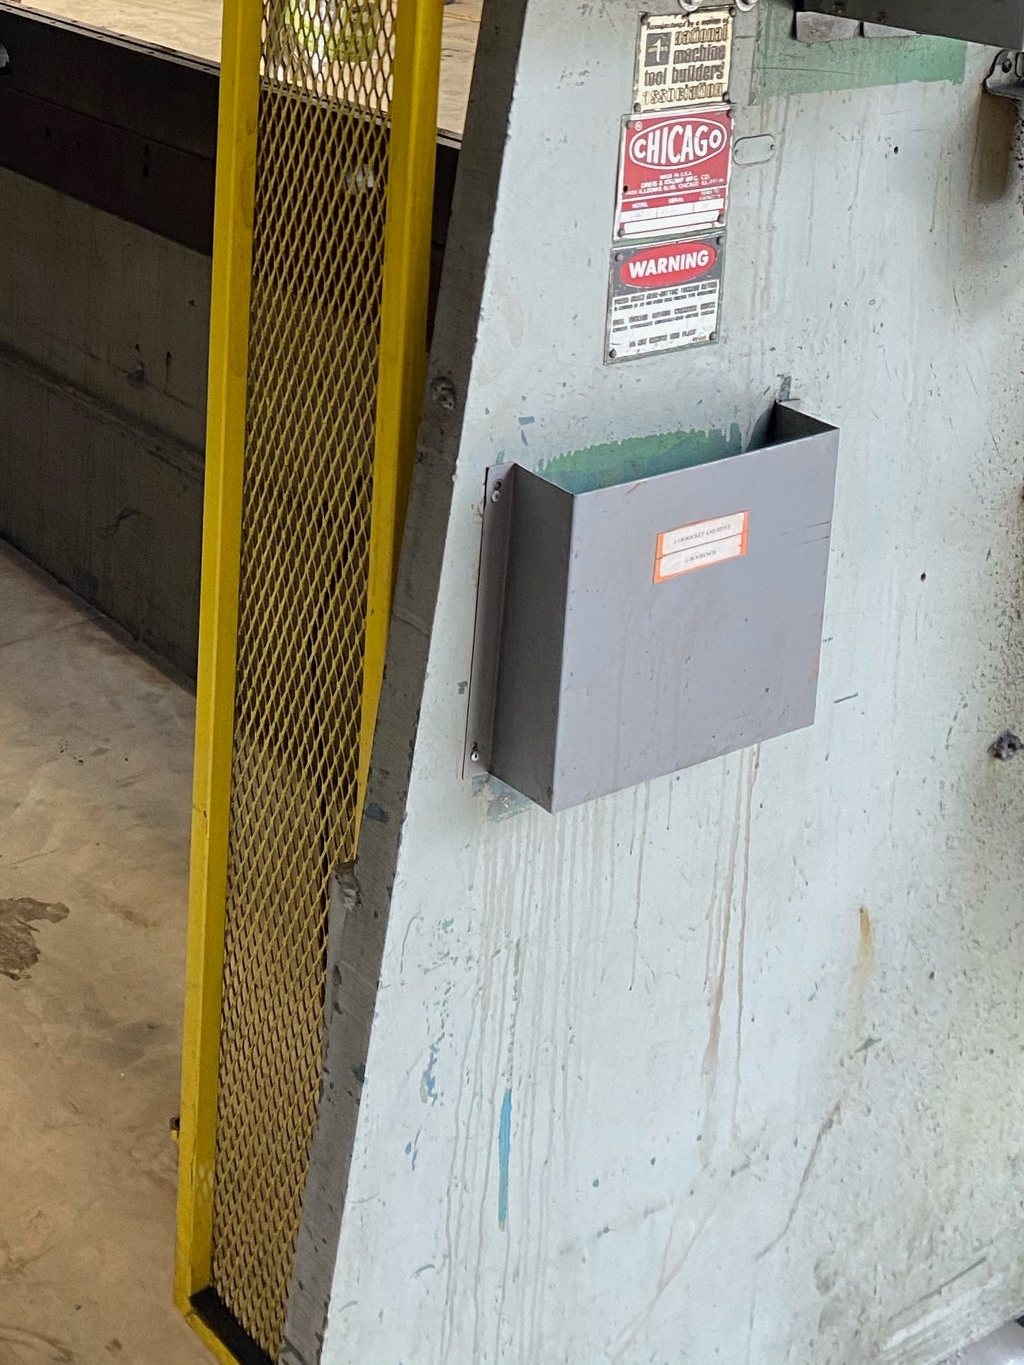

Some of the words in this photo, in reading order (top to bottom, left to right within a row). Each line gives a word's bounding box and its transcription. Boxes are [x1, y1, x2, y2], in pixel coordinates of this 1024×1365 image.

[675, 26, 727, 45] national
[673, 44, 726, 65] machine
[644, 68, 667, 86] tool
[671, 61, 725, 84] builders'
[642, 82, 724, 105] association
[634, 124, 722, 164] CHICAGO
[629, 249, 709, 278] WARNING
